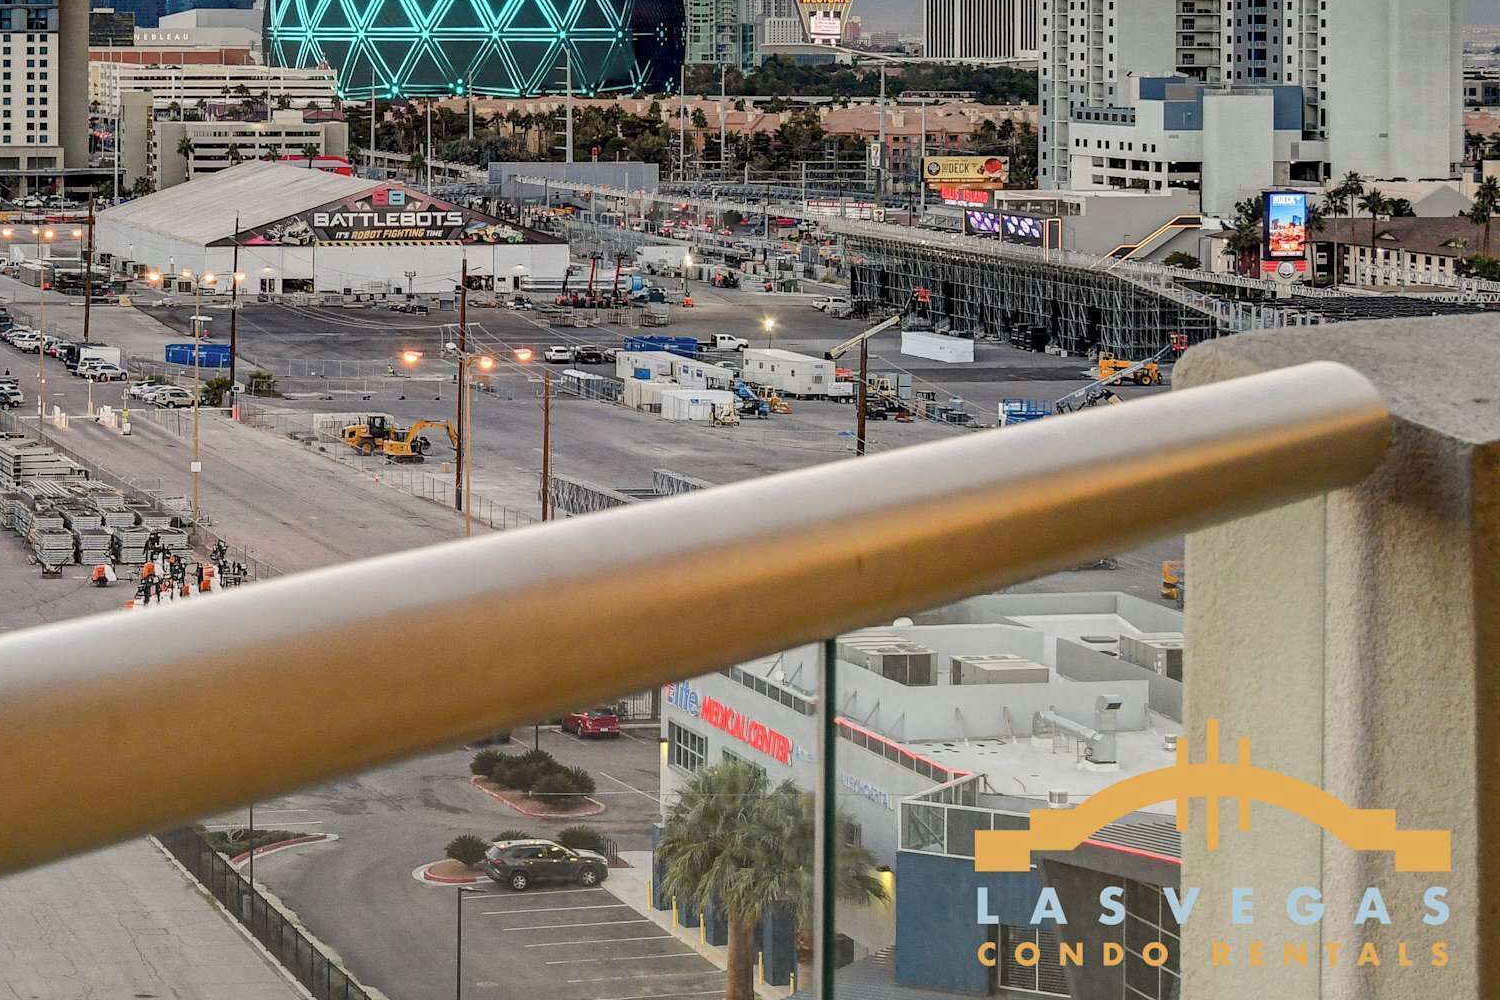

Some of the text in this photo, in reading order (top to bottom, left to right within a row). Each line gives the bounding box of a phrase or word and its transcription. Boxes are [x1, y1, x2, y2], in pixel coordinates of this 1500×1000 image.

[948, 162, 970, 174] DECK
[963, 189, 989, 204] ISLAND
[313, 212, 463, 227] BATTLEBOTS
[351, 230, 382, 240] ROBOT
[383, 228, 425, 239] FIGHTING
[426, 230, 444, 238] TIME
[701, 695, 747, 743] MEDICAL
[749, 720, 792, 766] CENTER
